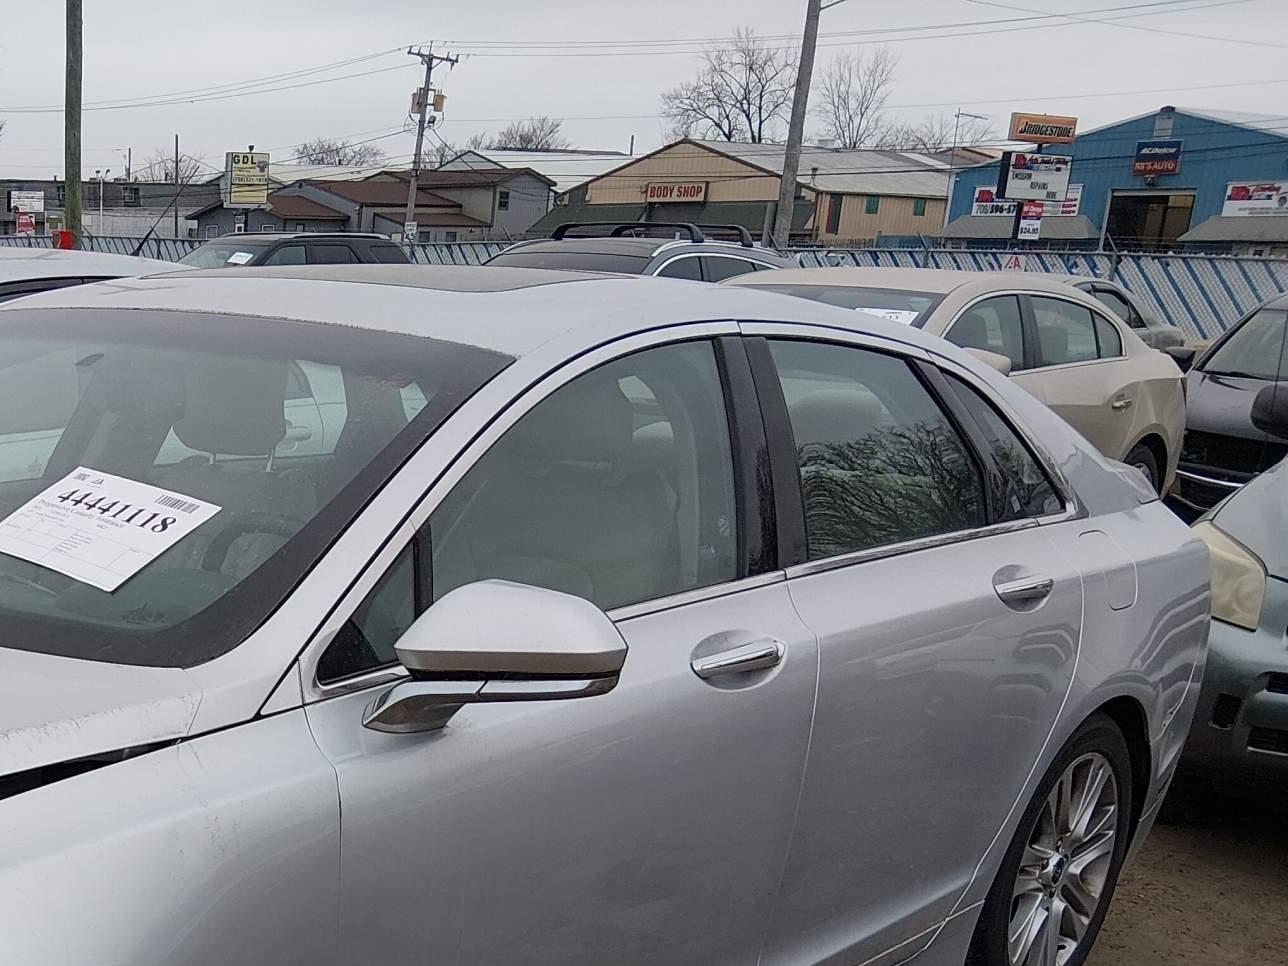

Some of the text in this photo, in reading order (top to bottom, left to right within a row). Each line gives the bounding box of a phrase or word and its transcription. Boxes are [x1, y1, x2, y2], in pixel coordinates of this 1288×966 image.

[1019, 121, 1073, 138] BRIDGESTONE
[233, 154, 257, 165] GDL
[1152, 160, 1175, 170] AUTO
[649, 185, 703, 198] BODY SHOP
[975, 204, 1016, 214] 708/596-57
[57, 488, 177, 533] 44441118
